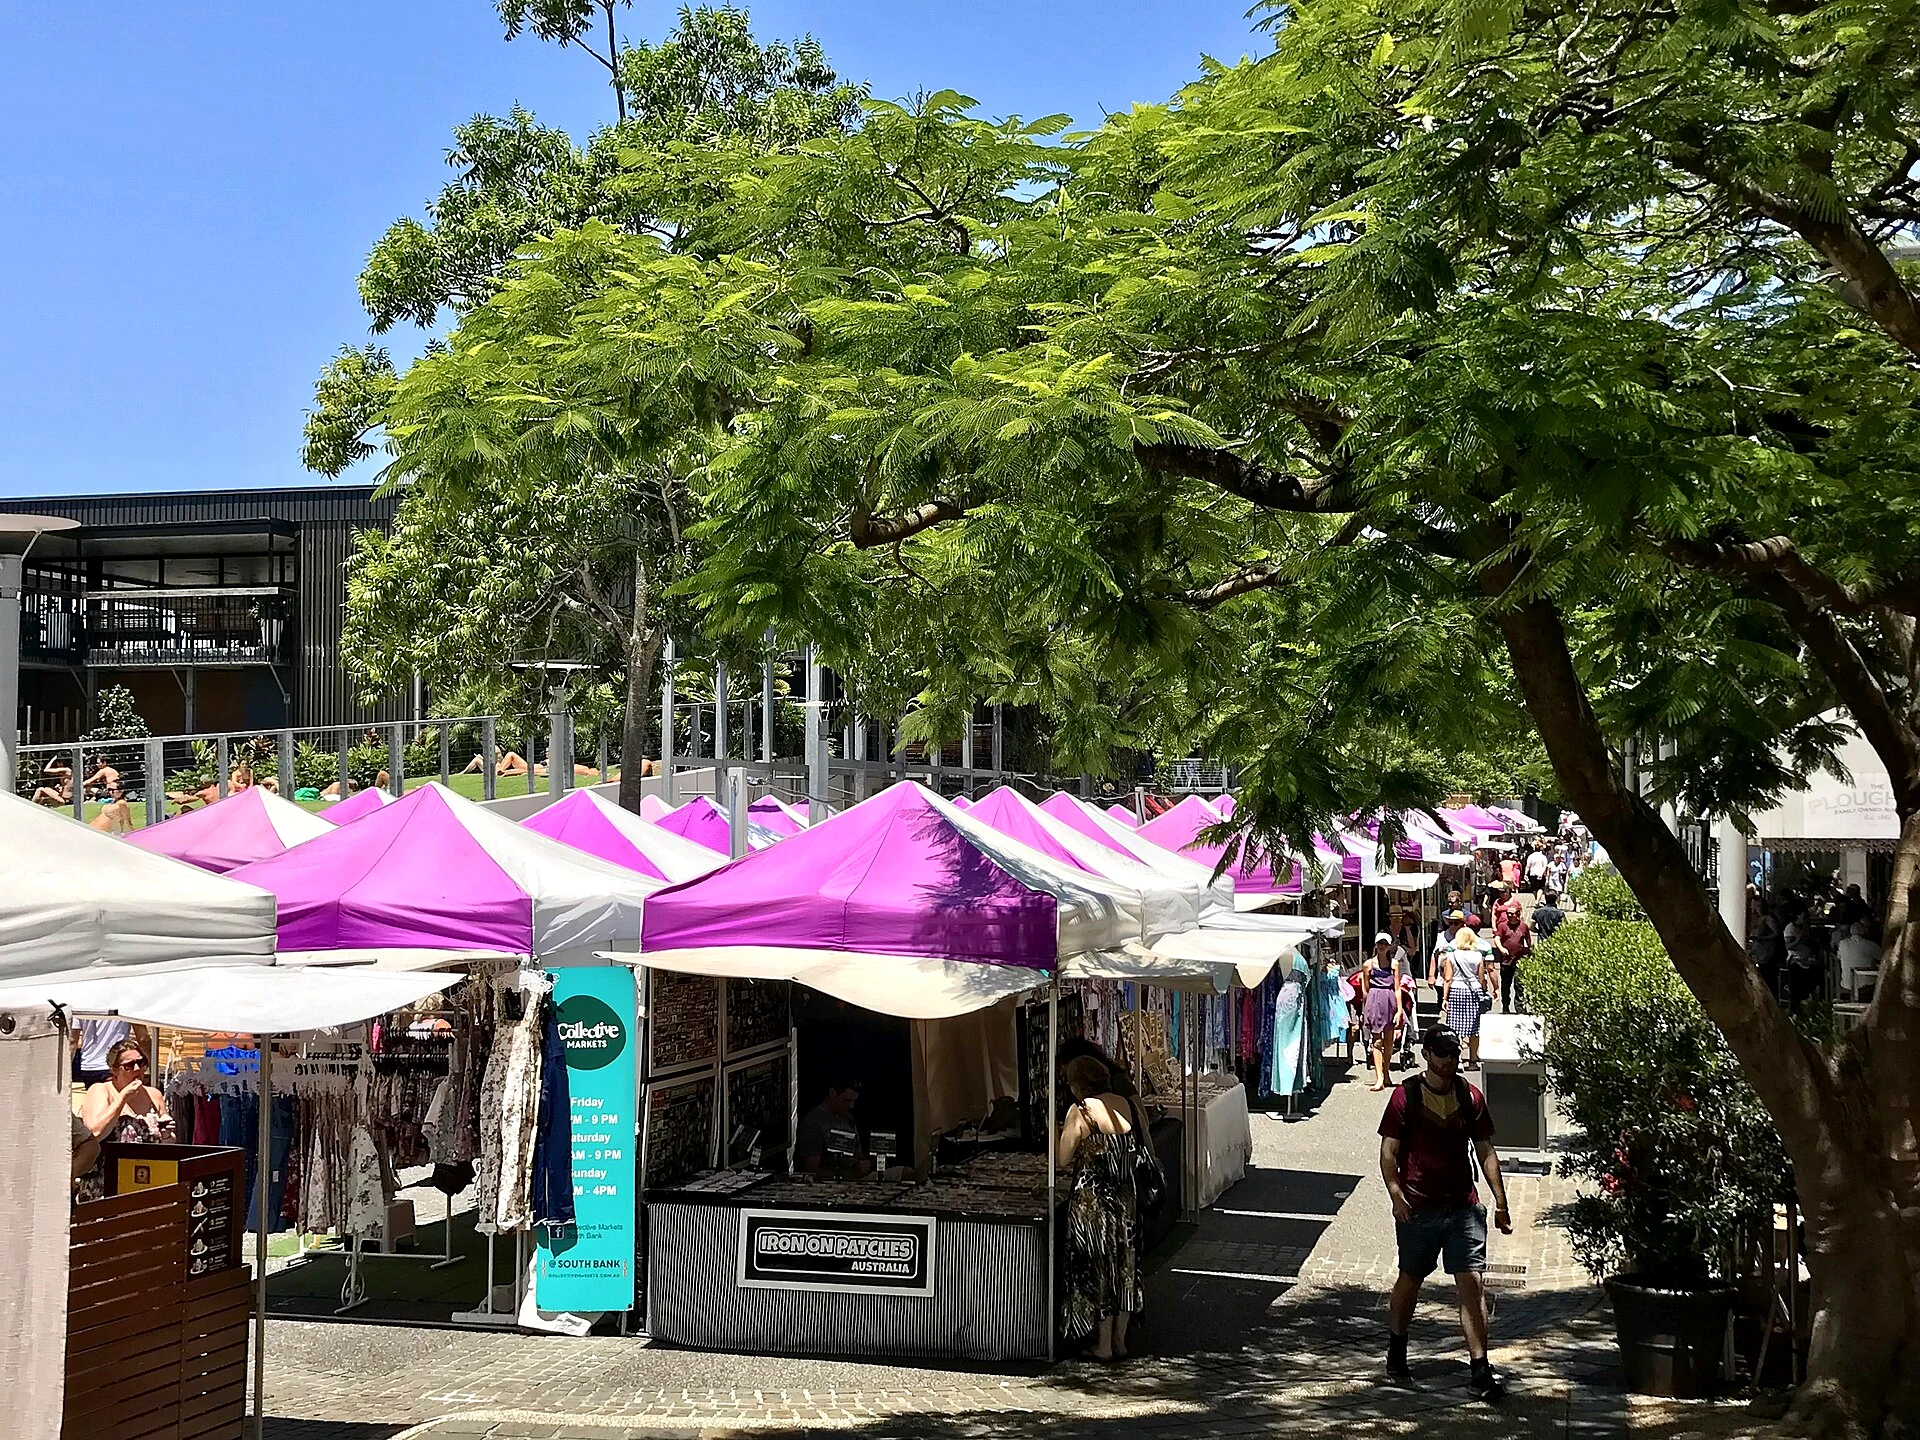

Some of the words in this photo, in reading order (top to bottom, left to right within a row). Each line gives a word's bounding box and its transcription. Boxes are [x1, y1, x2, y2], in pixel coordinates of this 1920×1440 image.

[557, 1021, 619, 1040] Collective
[567, 1040, 607, 1048] MARKETS
[570, 1097, 604, 1109] Friday
[591, 1114, 599, 1124] 9
[601, 1114, 618, 1124] PM
[571, 1132, 611, 1144] aturday
[594, 1149, 602, 1160] 9
[604, 1149, 622, 1160] PM
[573, 1185, 584, 1196] M
[592, 1185, 617, 1196] 4PM
[598, 1223, 624, 1231] Markets
[586, 1232, 603, 1240] Bank
[761, 1234, 804, 1252] IRON
[807, 1236, 833, 1253] ON
[837, 1239, 911, 1258] PATCHES
[548, 1260, 557, 1269] @
[558, 1260, 591, 1268] SOUTH
[593, 1260, 621, 1268] BANK
[851, 1261, 909, 1273] AUSTRALIA
